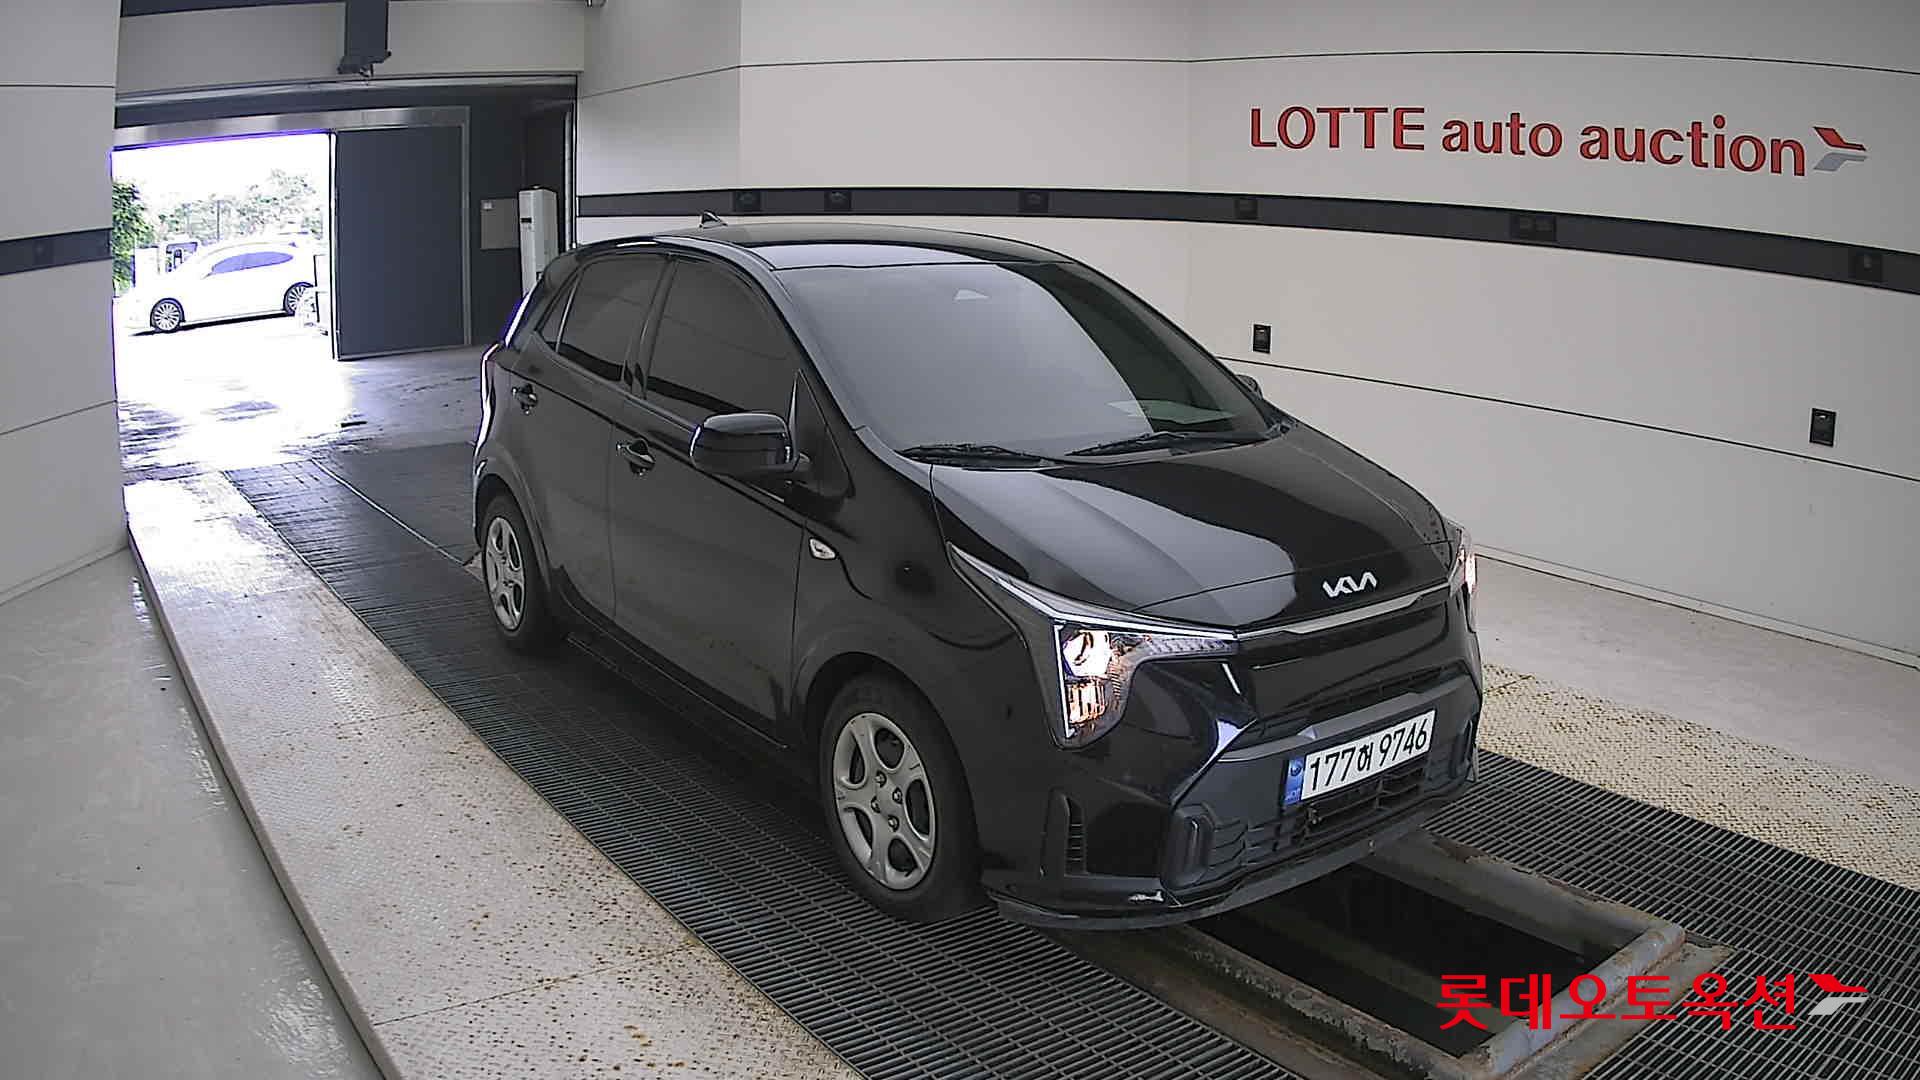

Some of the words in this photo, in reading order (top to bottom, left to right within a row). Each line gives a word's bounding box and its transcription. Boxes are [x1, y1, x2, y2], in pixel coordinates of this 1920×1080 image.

[1251, 106, 1425, 150] LOTTE
[1441, 112, 1564, 158] auto
[1579, 115, 1806, 177] auction
[1323, 571, 1377, 597] KIA
[1310, 742, 1374, 790] 177허
[1380, 718, 1428, 767] 9746
